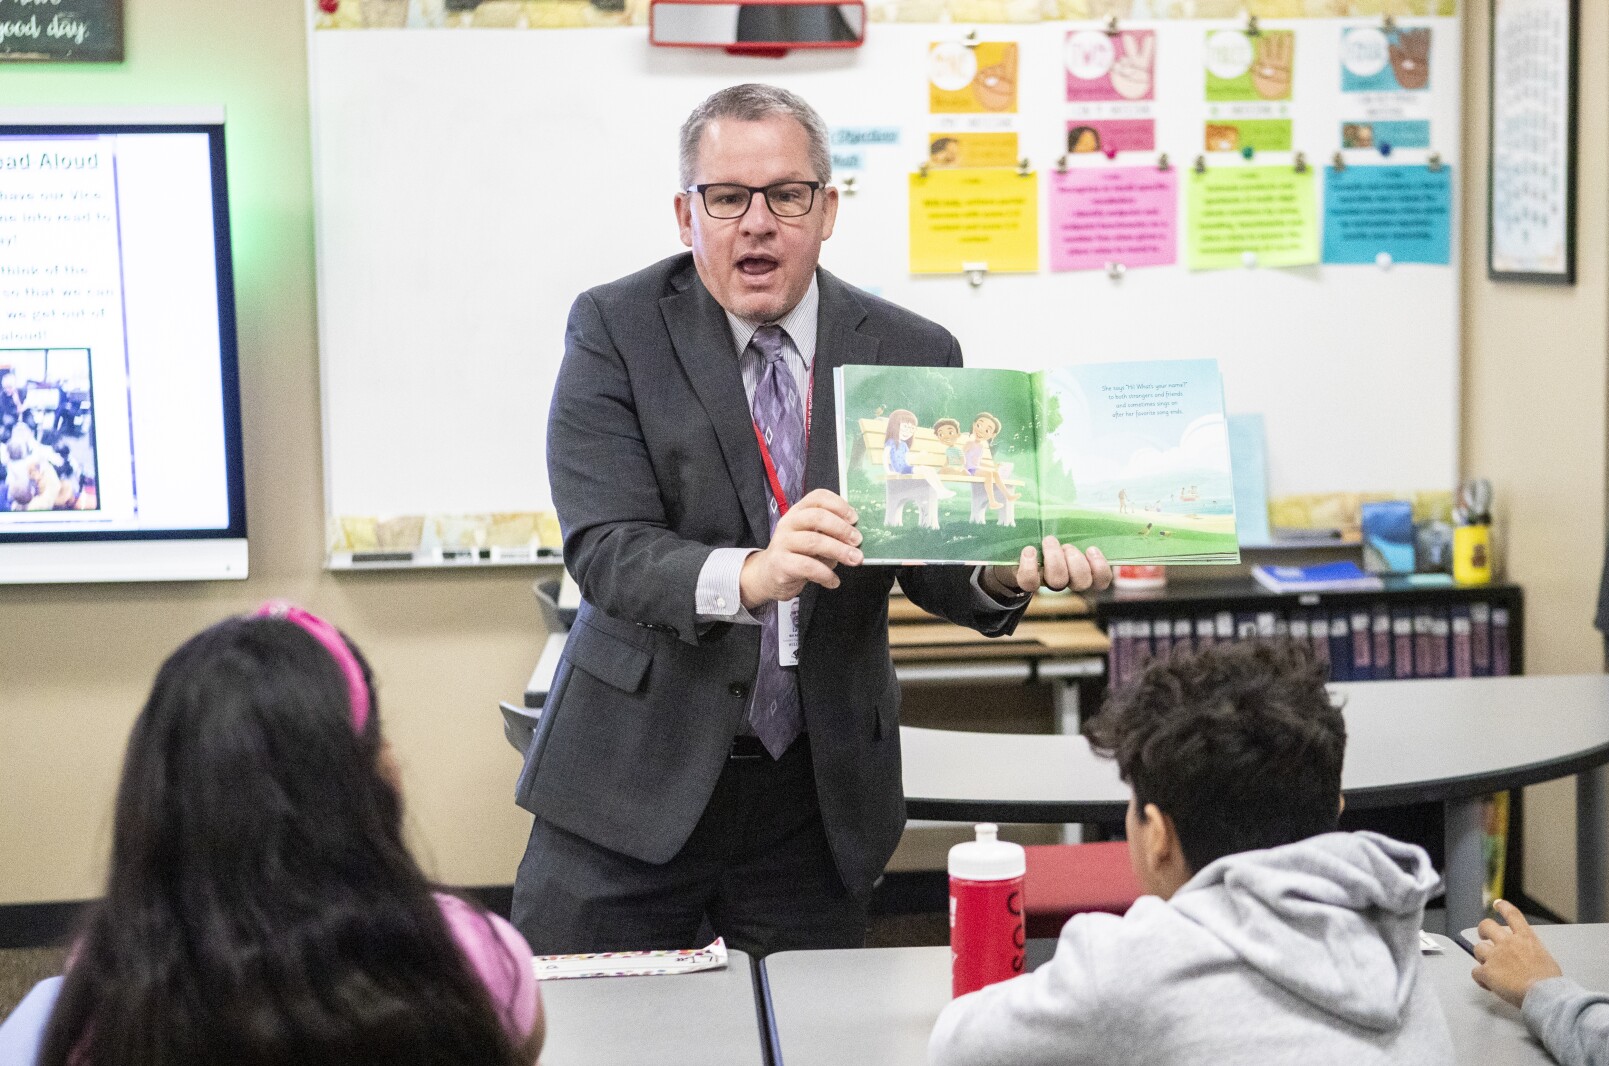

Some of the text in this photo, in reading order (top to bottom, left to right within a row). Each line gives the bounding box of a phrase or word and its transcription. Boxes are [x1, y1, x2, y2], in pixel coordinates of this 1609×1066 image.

[46, 14, 90, 45] day.
[40, 153, 98, 170] Aloud
[58, 212, 90, 222] read
[96, 212, 110, 222] to
[45, 265, 59, 275] of
[65, 265, 88, 274] the
[25, 287, 55, 296] that
[63, 289, 81, 297] we
[7, 311, 26, 319] we
[1112, 385, 1125, 393] says
[1128, 393, 1153, 401] strangers
[1165, 390, 1184, 399] friends
[1156, 400, 1170, 409] sings
[1111, 411, 1124, 420] after
[1135, 409, 1156, 419] favorite
